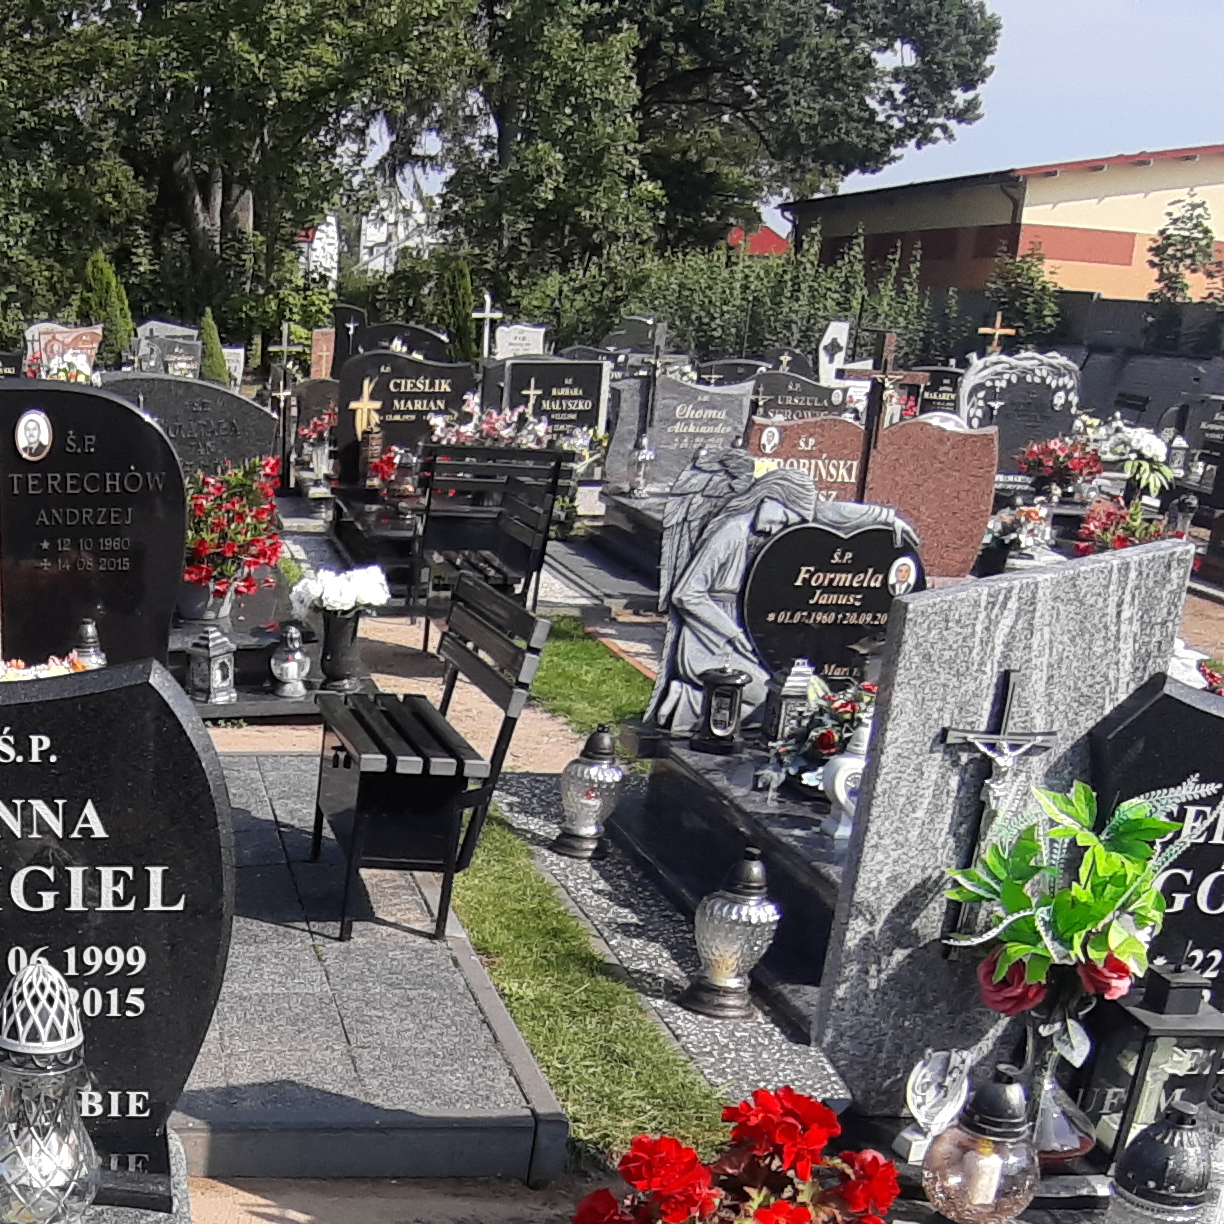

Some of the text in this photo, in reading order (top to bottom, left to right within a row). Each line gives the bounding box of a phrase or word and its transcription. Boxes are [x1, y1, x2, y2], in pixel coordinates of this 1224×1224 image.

[389, 375, 453, 393] CIEŚLIK
[392, 399, 447, 411] MARIAN
[777, 395, 829, 407] URSZULA
[8, 464, 167, 495] TERECHÓW
[35, 507, 134, 527] ANDRZEJ
[57, 537, 131, 551] 12 10 1960
[57, 558, 72, 572] 14
[99, 557, 131, 571] 2015
[794, 566, 885, 588] Formela
[809, 589, 864, 606] Janusz
[63, 945, 147, 977] 1999
[79, 1090, 151, 1118] BIE
